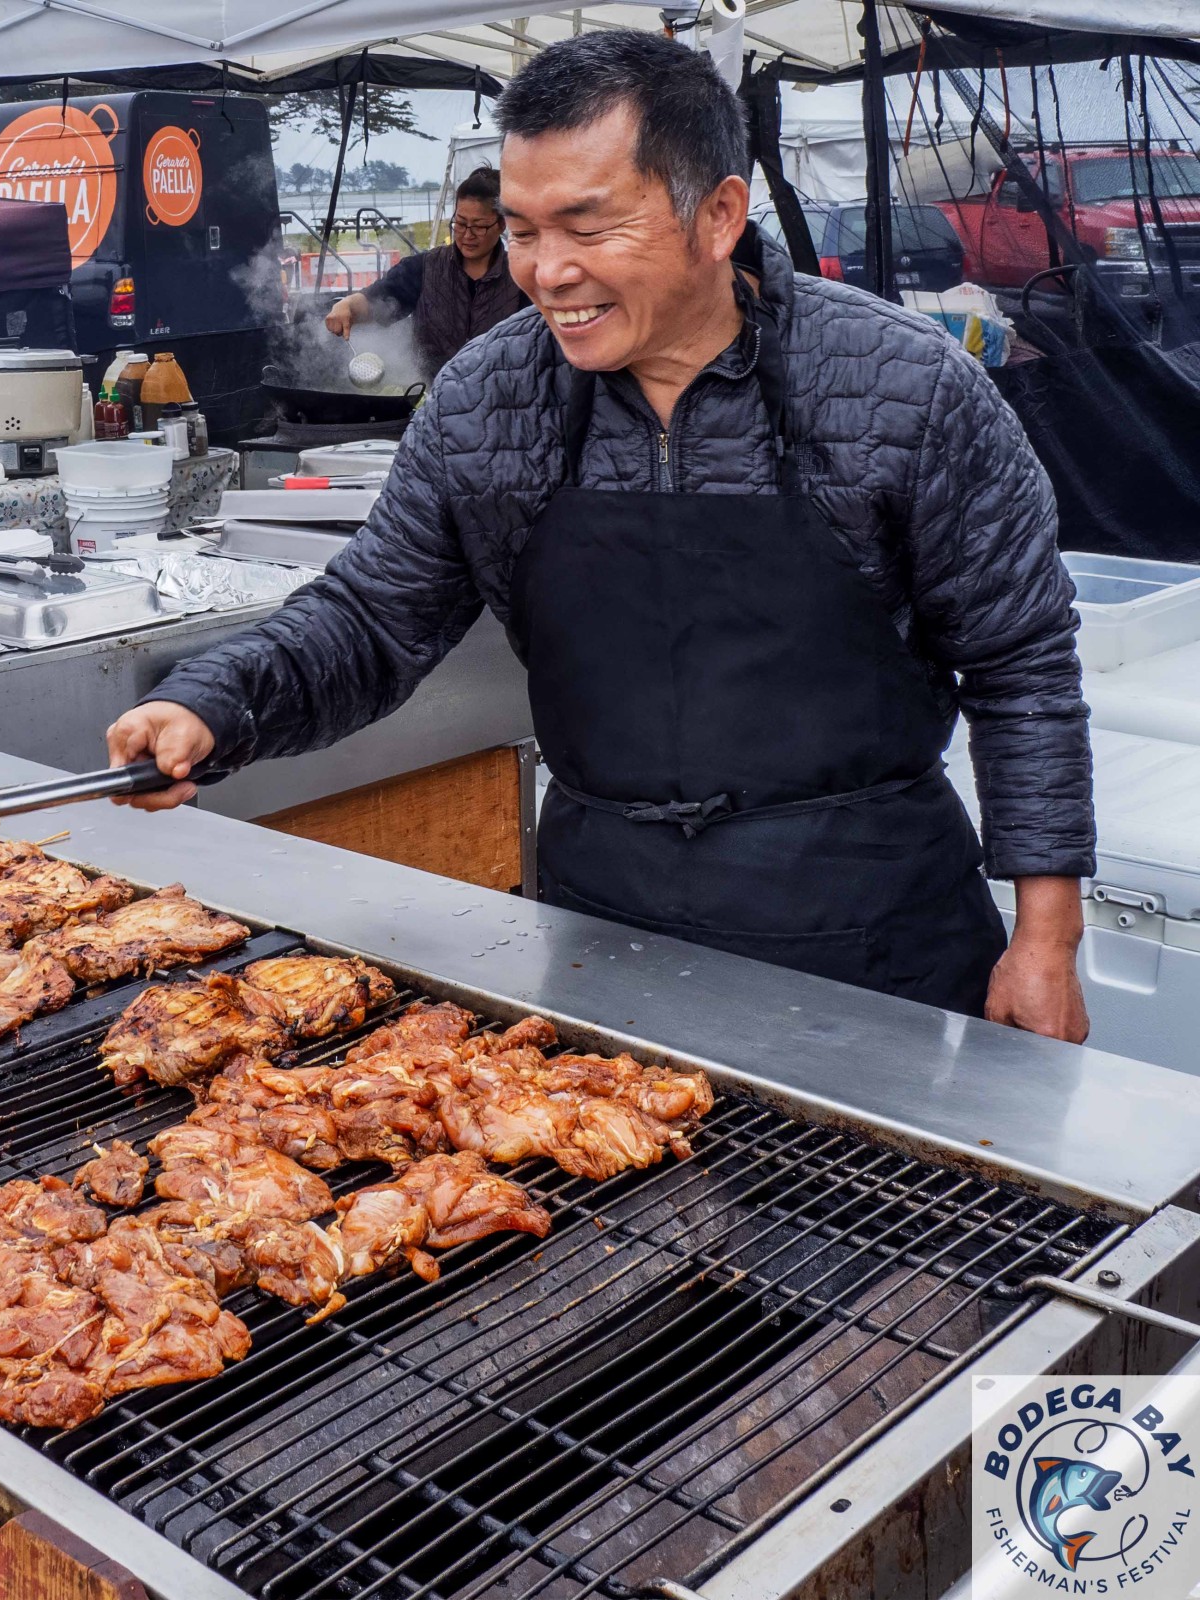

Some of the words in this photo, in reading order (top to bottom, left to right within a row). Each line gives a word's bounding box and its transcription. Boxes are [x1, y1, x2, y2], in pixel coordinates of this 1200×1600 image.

[156, 154, 190, 169] Gerard's
[152, 168, 195, 194] PAELLA
[150, 327, 170, 335] LEER
